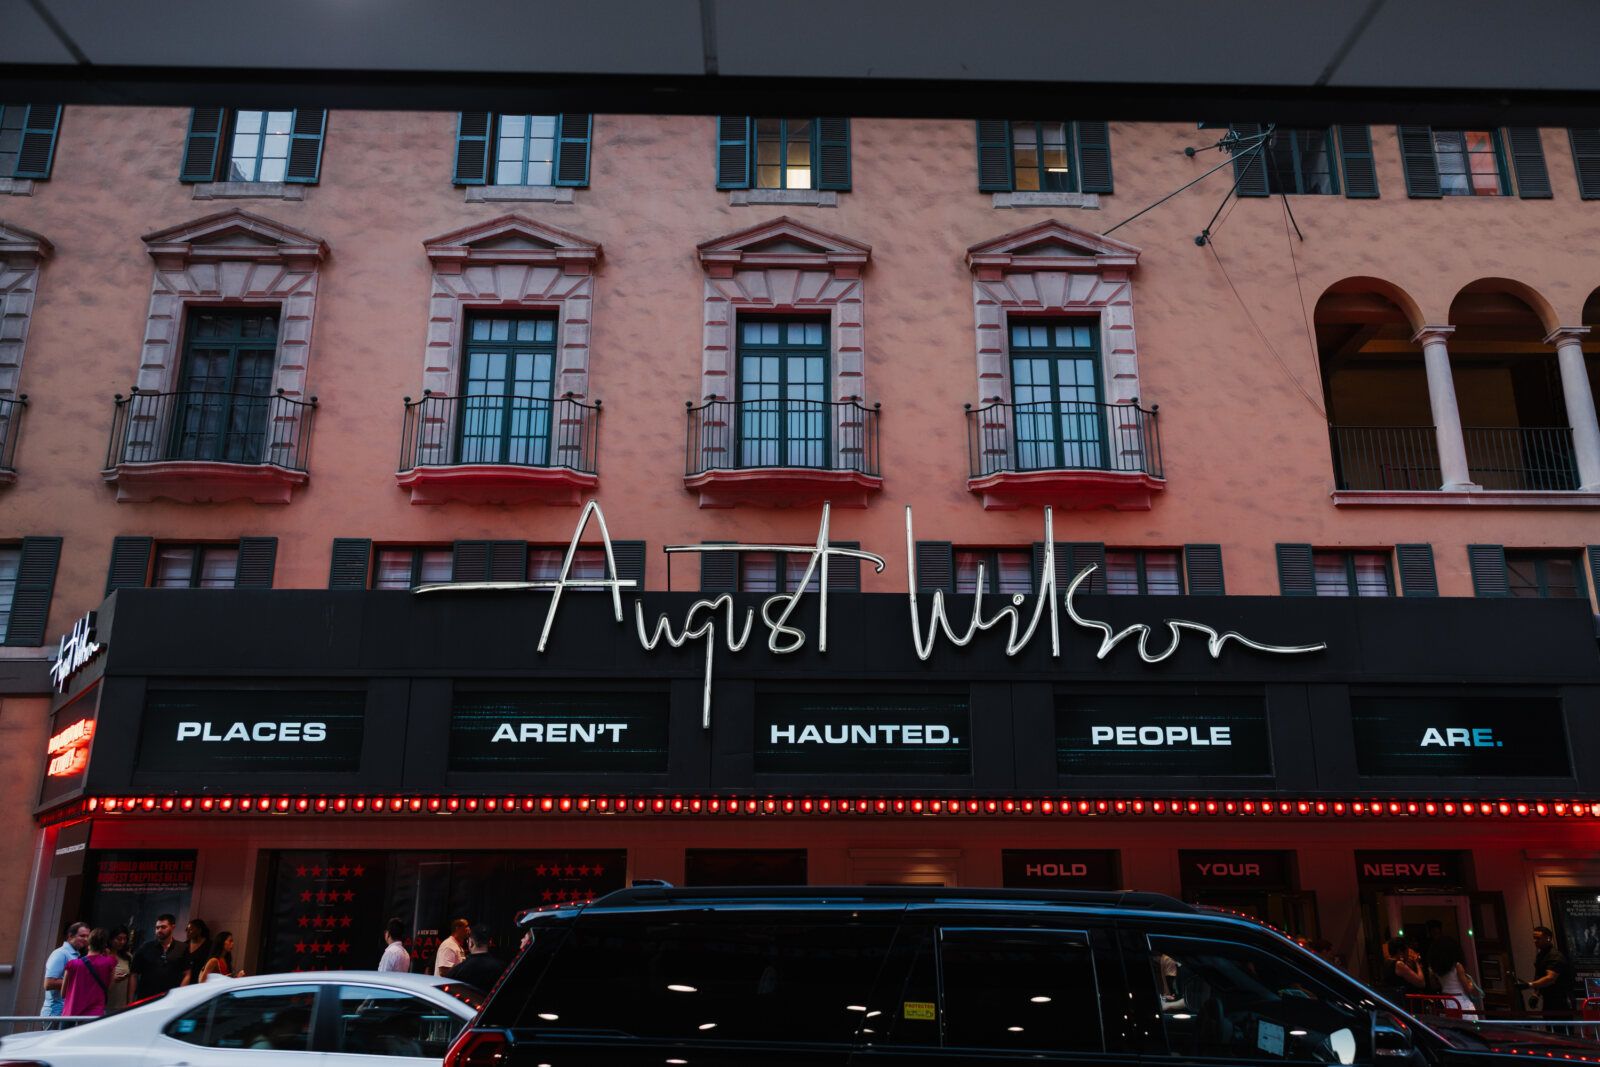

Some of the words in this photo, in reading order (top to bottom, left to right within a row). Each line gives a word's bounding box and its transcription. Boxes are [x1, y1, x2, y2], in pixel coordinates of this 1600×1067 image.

[412, 499, 886, 729] August
[905, 504, 1327, 663] Wilson
[176, 721, 327, 743] PLACES
[491, 723, 628, 743] AREN'T
[770, 724, 960, 744] HAUNTED.
[1091, 726, 1232, 746] PEOPLE
[1420, 727, 1504, 747] ARE.
[1026, 863, 1087, 877] HOLD
[1197, 863, 1260, 876] YOUR
[1363, 863, 1447, 877] NERVE.
